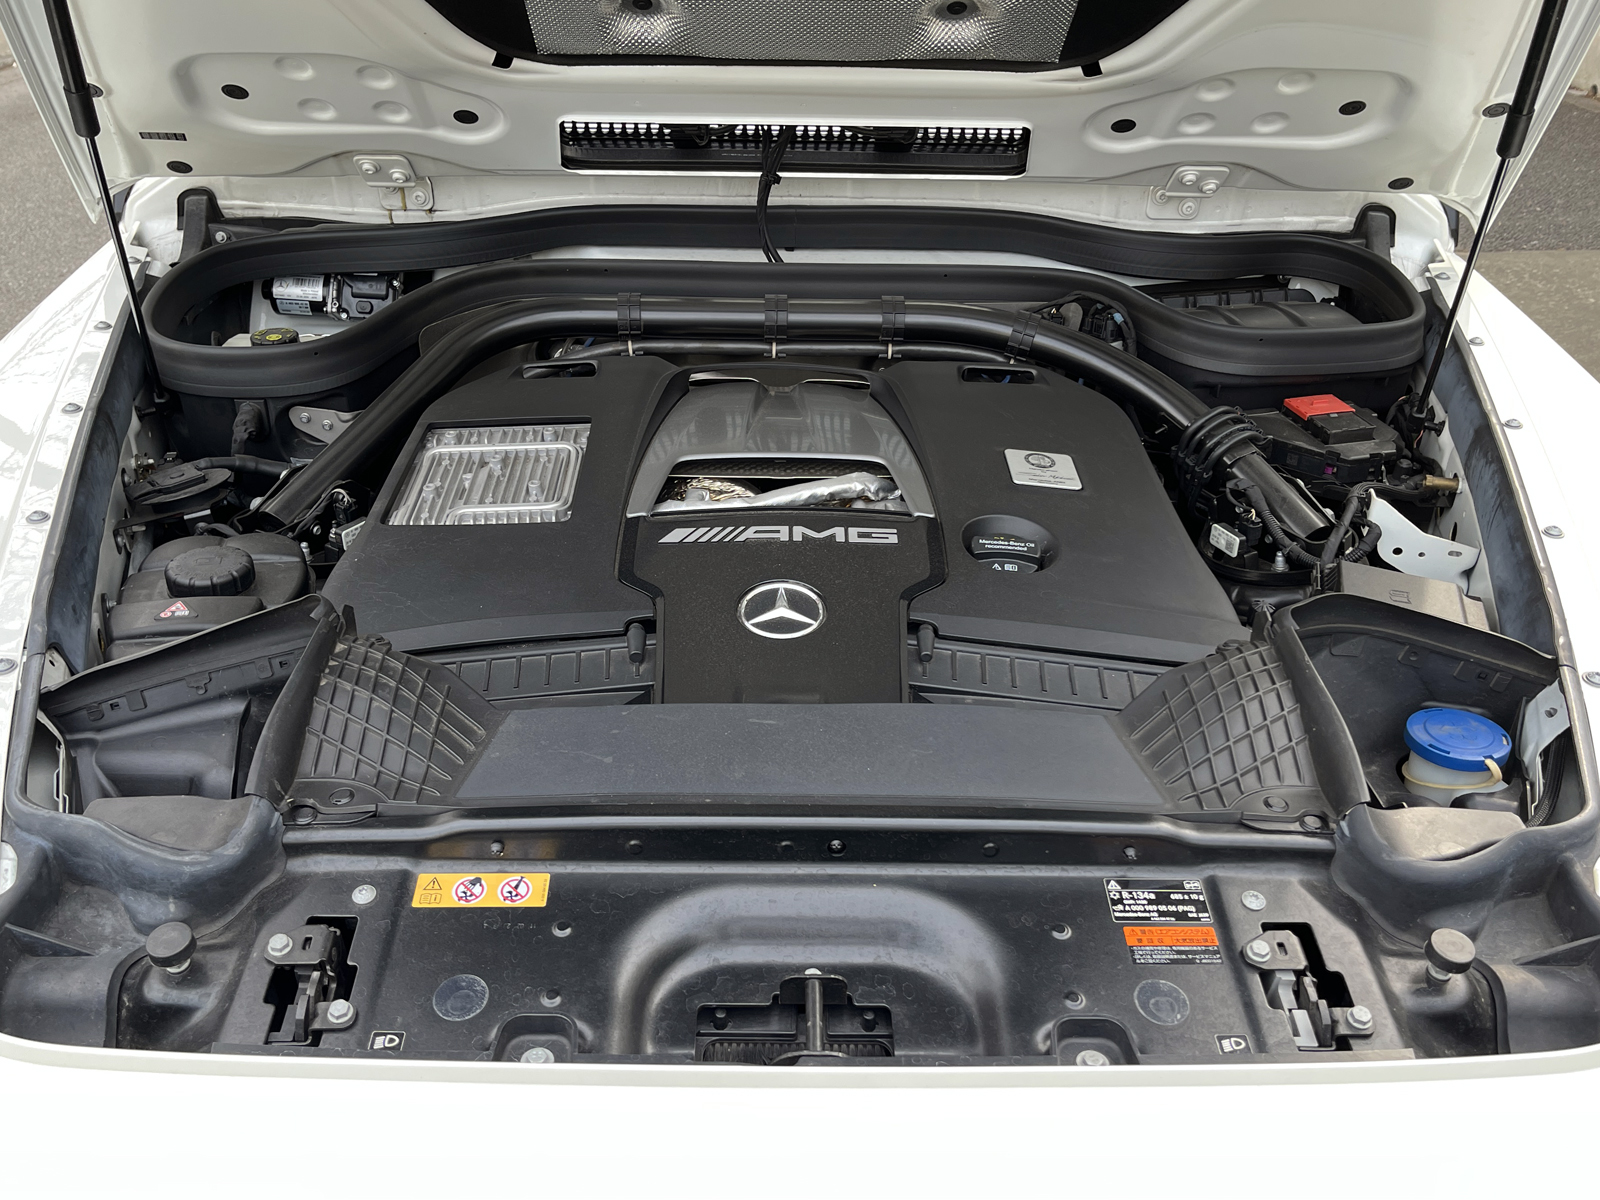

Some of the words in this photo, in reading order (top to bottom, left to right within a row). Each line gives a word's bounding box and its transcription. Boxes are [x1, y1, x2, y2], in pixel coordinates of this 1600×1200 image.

[734, 526, 898, 543] AMG
[979, 538, 1025, 547] Mercedes-Benz
[1121, 891, 1156, 900] R-134a
